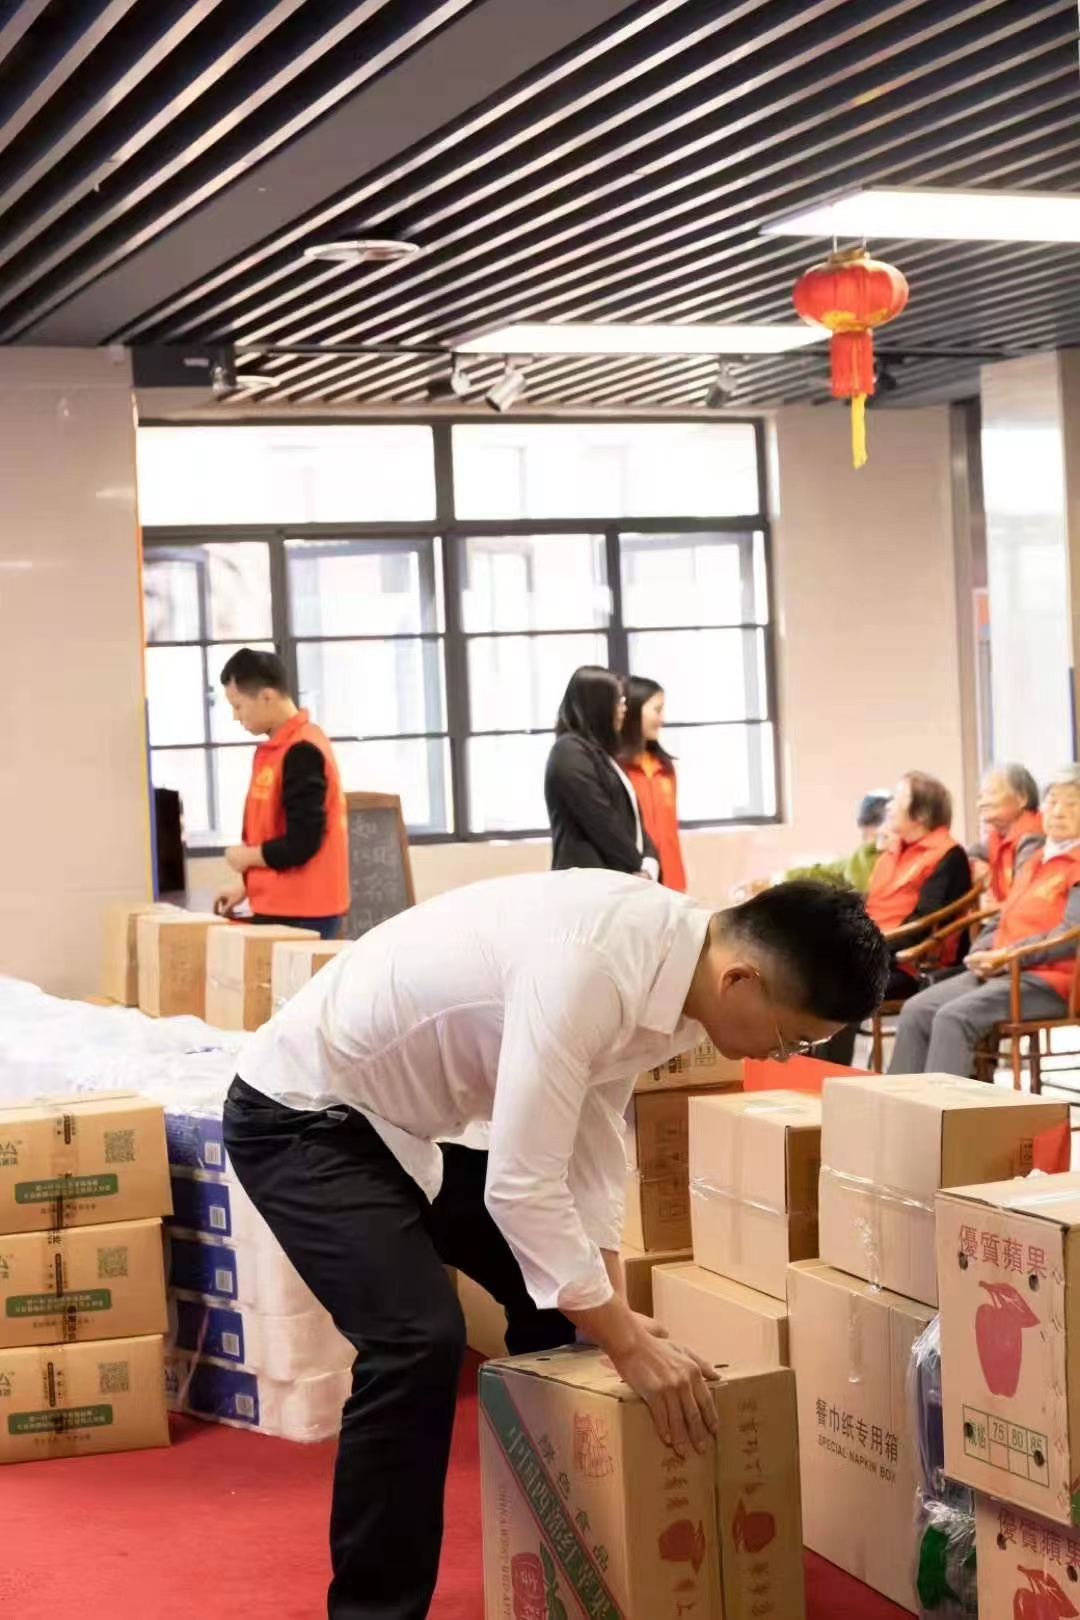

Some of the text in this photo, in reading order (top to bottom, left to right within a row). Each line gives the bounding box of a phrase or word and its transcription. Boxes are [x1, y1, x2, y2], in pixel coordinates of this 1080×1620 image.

[959, 1224, 1047, 1279] 優質蘋果
[815, 1397, 898, 1463] 餐巾纸专用箱
[993, 1422, 1005, 1441] 75
[1012, 1428, 1024, 1449] 80
[817, 1434, 897, 1483] SPECIAL NAPKIN BOX
